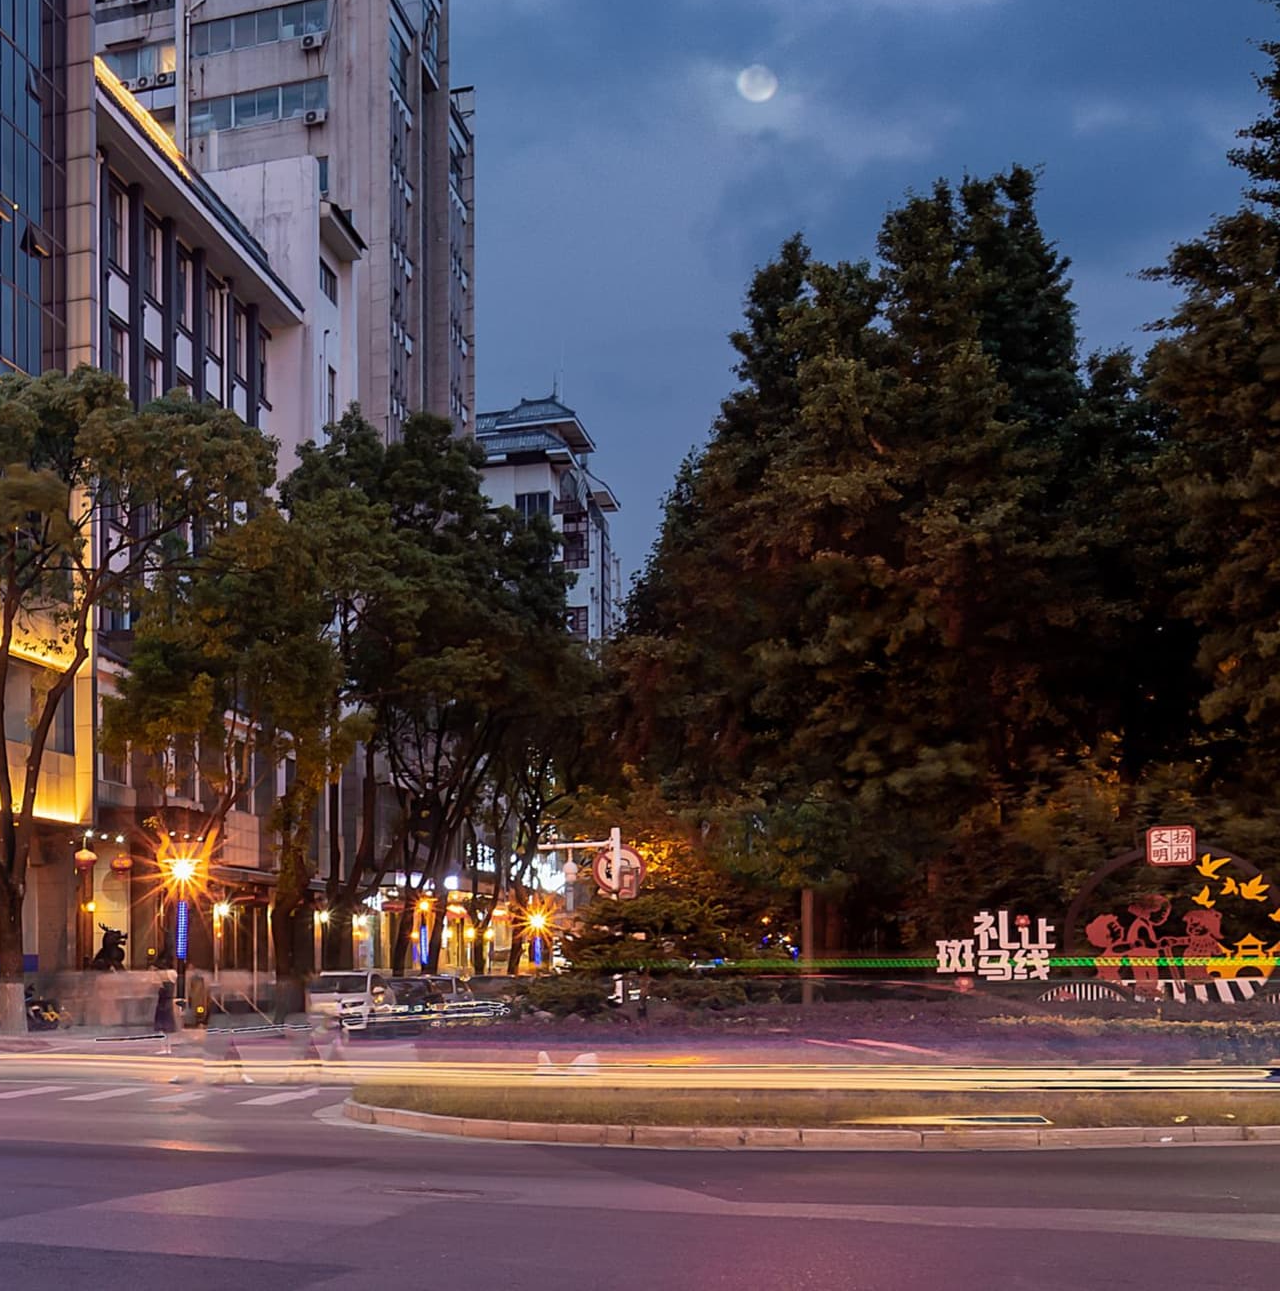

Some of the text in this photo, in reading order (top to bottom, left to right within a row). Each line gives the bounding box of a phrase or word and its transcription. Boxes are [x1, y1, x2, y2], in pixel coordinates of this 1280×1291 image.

[973, 910, 1056, 950] 礼让
[936, 939, 1050, 981] 斑马线
